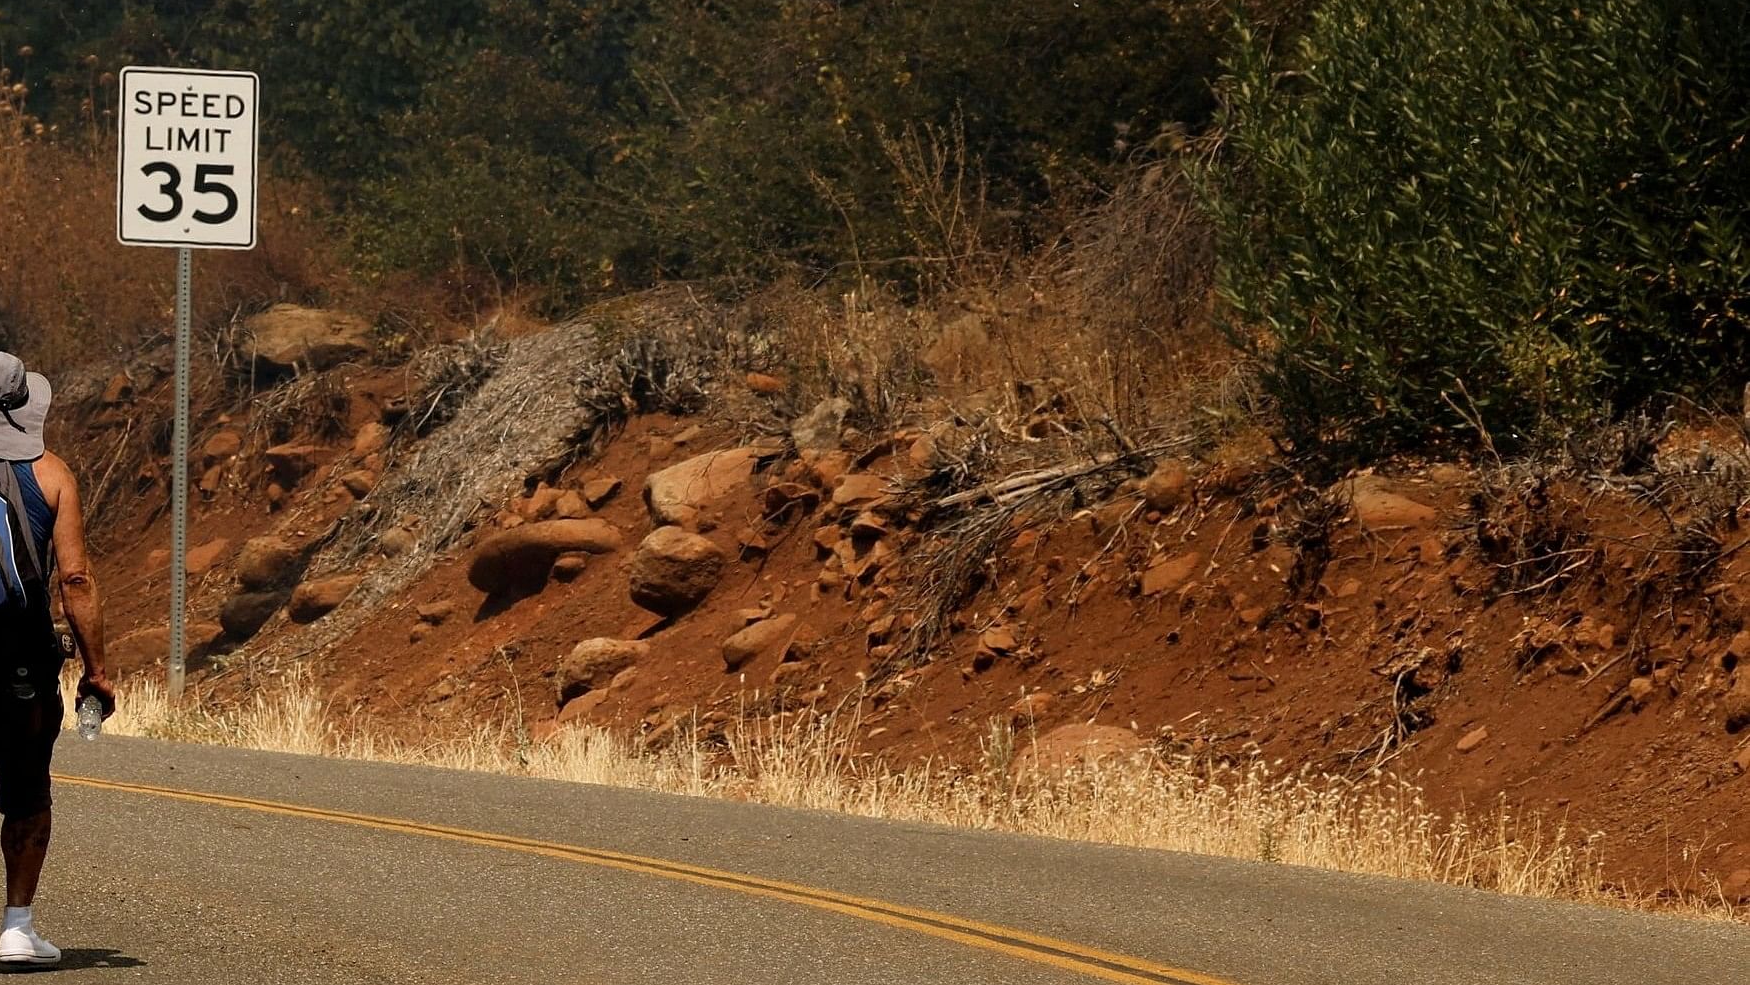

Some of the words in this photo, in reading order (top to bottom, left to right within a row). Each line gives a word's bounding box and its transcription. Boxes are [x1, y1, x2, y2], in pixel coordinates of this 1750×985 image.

[134, 90, 245, 118] SPEED
[146, 126, 231, 152] LIMIT
[137, 161, 239, 224] 35
